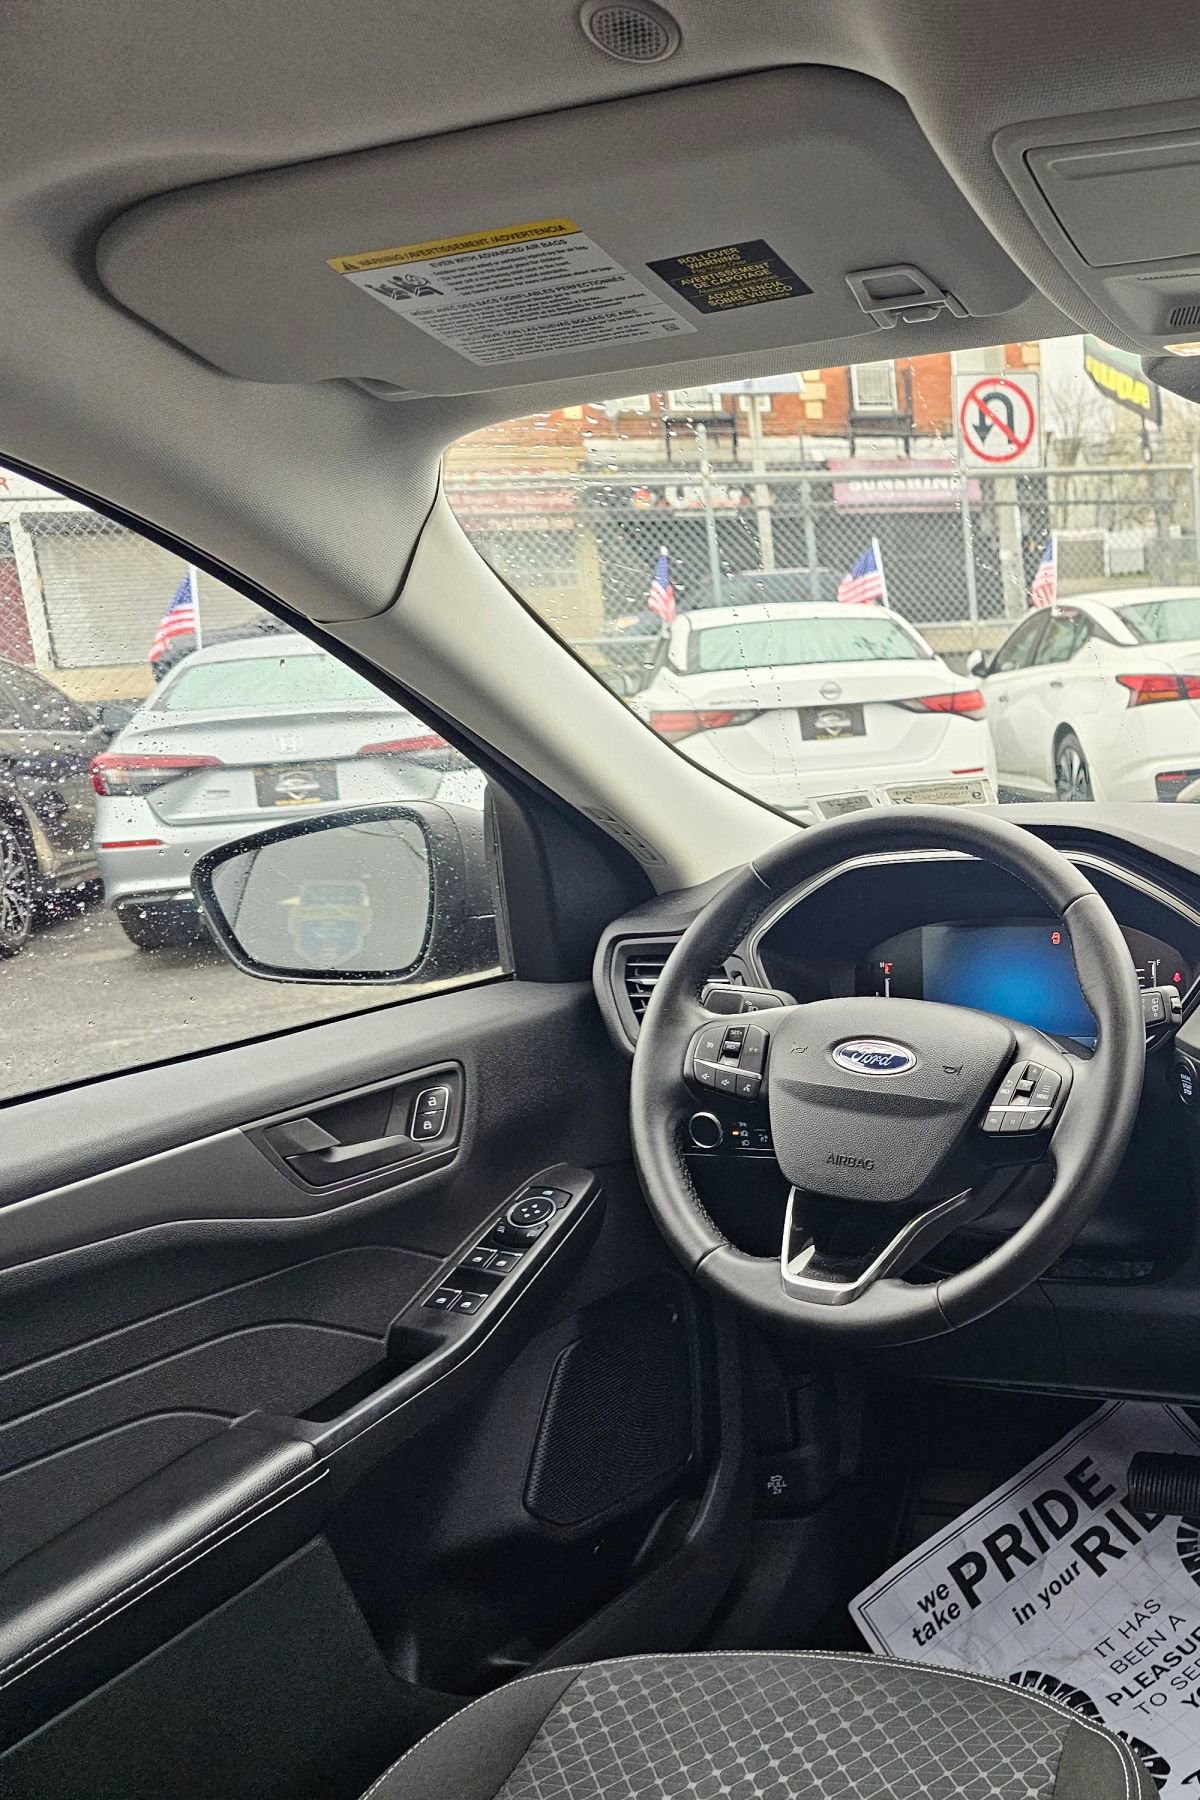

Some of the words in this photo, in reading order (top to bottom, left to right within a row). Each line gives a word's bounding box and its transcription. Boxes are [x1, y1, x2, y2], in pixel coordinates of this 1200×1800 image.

[677, 247, 740, 265] ROLLOVER
[688, 253, 741, 271] WARNING
[680, 261, 770, 286] AVERTISSEMENT
[694, 279, 711, 290] DE
[711, 268, 772, 287] CAPOTAGE
[707, 280, 784, 301] ADVERTENCIA
[707, 291, 746, 307] SOBRE
[748, 284, 793, 300] VUELCO
[850, 1045, 894, 1067] Ford
[825, 1152, 875, 1171] AIRBAG
[916, 1583, 951, 1614] we
[946, 1455, 1117, 1611] PRIDE
[1011, 1599, 1037, 1626] in
[1037, 1560, 1081, 1610] your
[911, 1602, 962, 1647] take
[1094, 1636, 1116, 1659] IT
[1117, 1599, 1161, 1640] HAS
[1109, 1629, 1168, 1675] BEEN
[1167, 1614, 1187, 1632] A
[1132, 1692, 1168, 1715] TO
